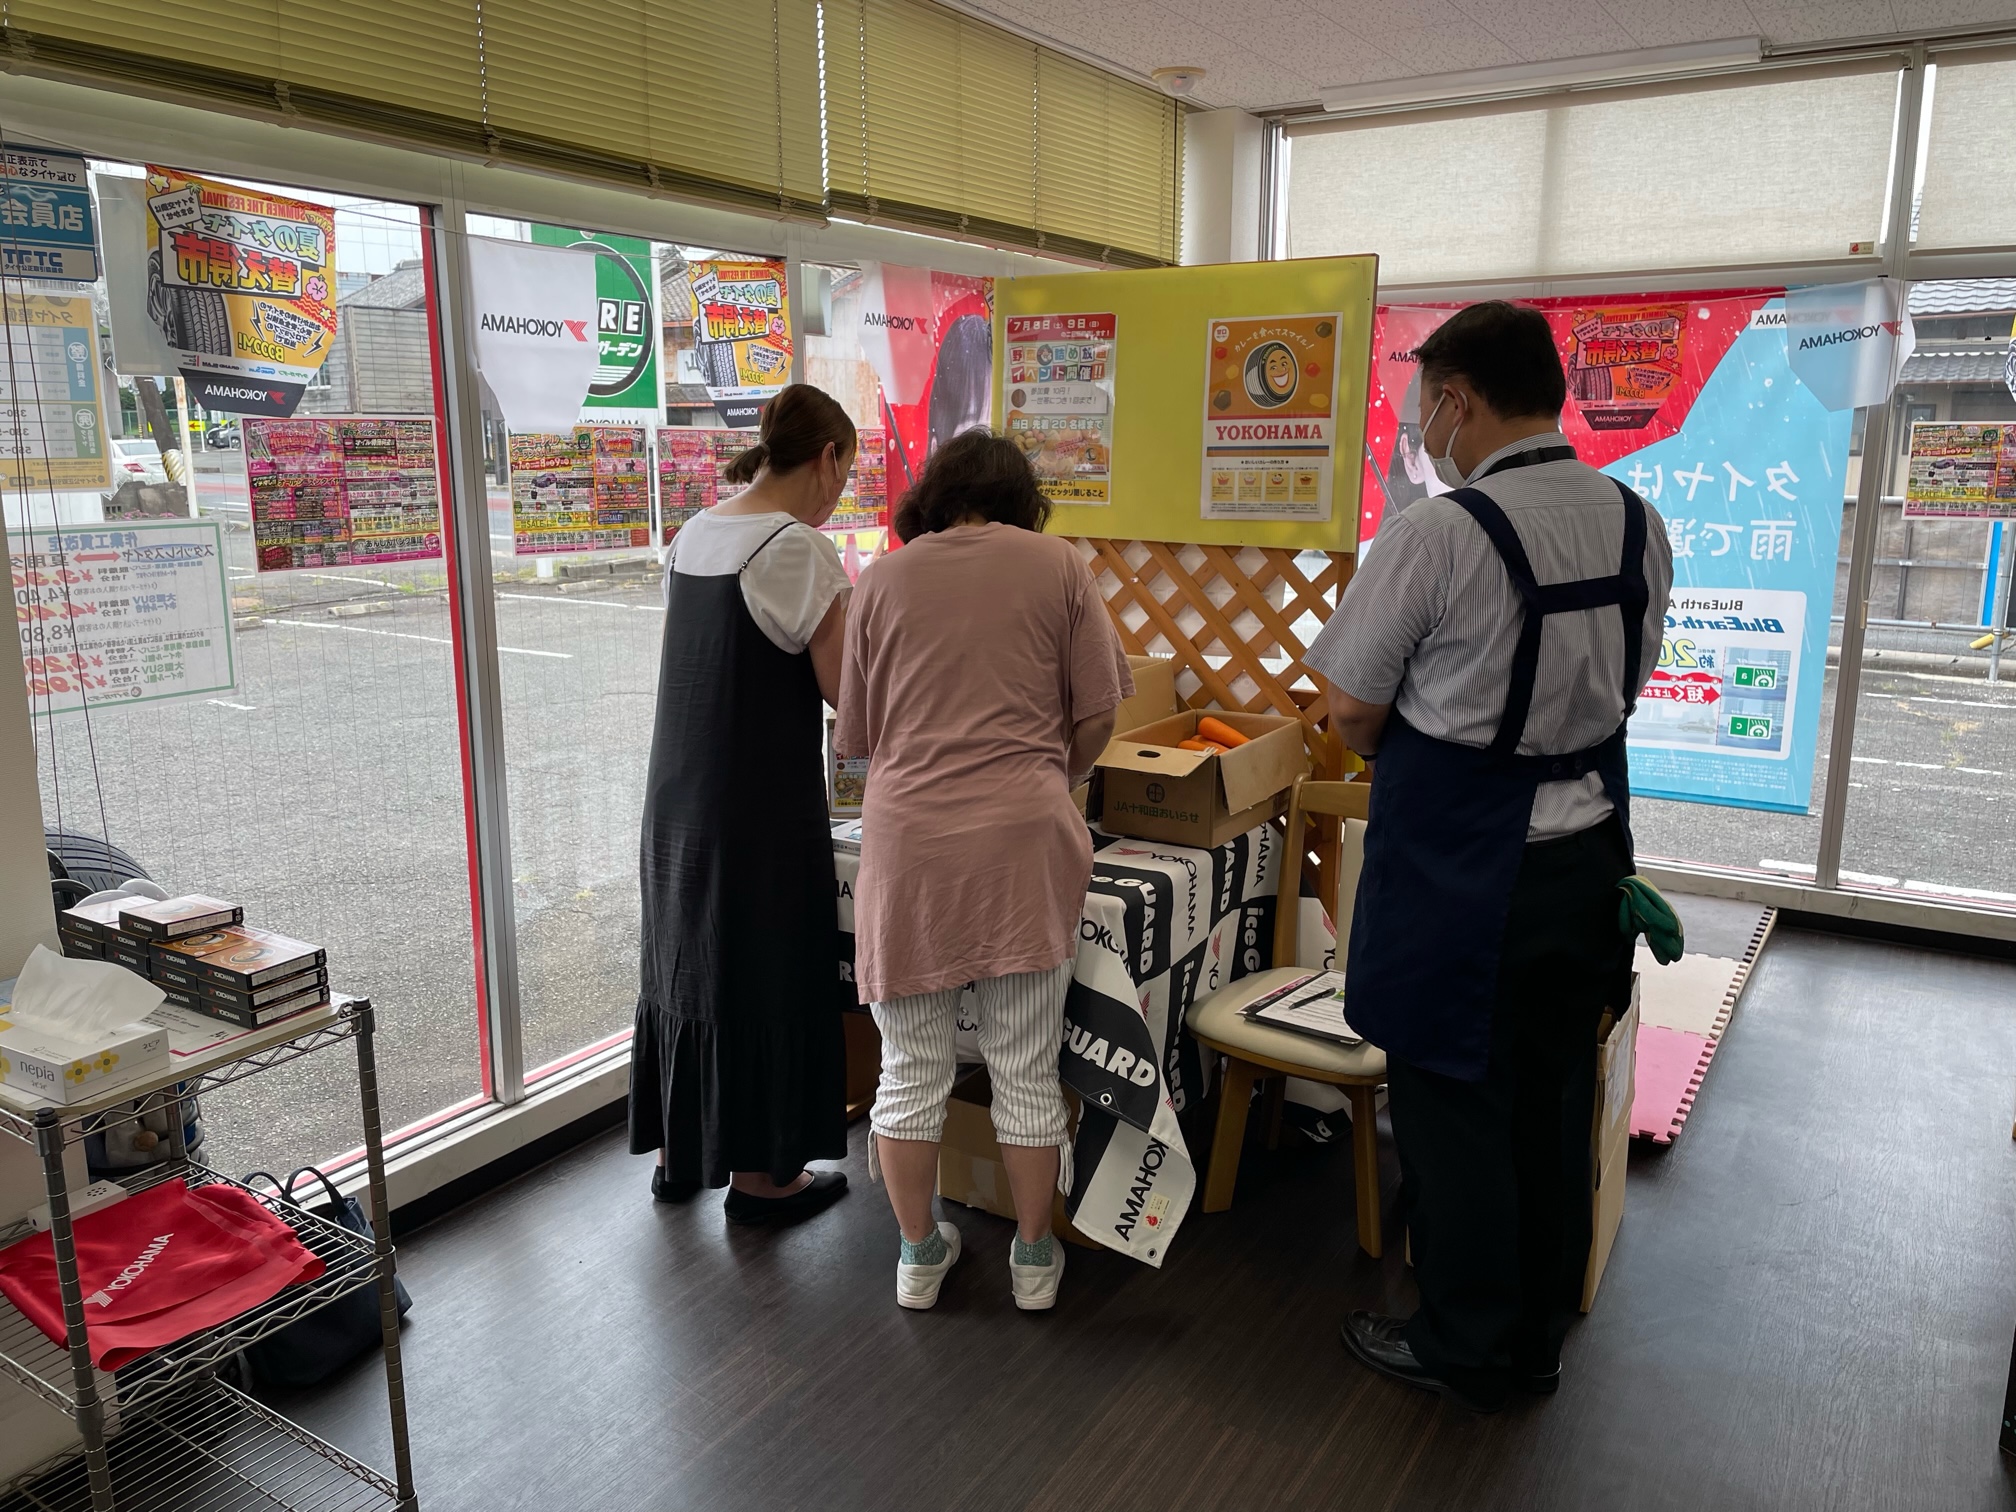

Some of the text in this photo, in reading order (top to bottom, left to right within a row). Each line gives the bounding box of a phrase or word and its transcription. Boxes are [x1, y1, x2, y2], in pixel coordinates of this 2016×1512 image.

[1, 199, 83, 231] 会員店
[1052, 419, 1066, 430] 20
[1216, 424, 1323, 441] YOKOHAMA
[1114, 801, 1199, 823] JA十和田おいらせ
[1150, 852, 1198, 942] YOKOHAMA
[1244, 907, 1264, 975] iceG
[20, 1060, 55, 1082] nepia
[102, 1233, 174, 1291] YOKOHAMA
